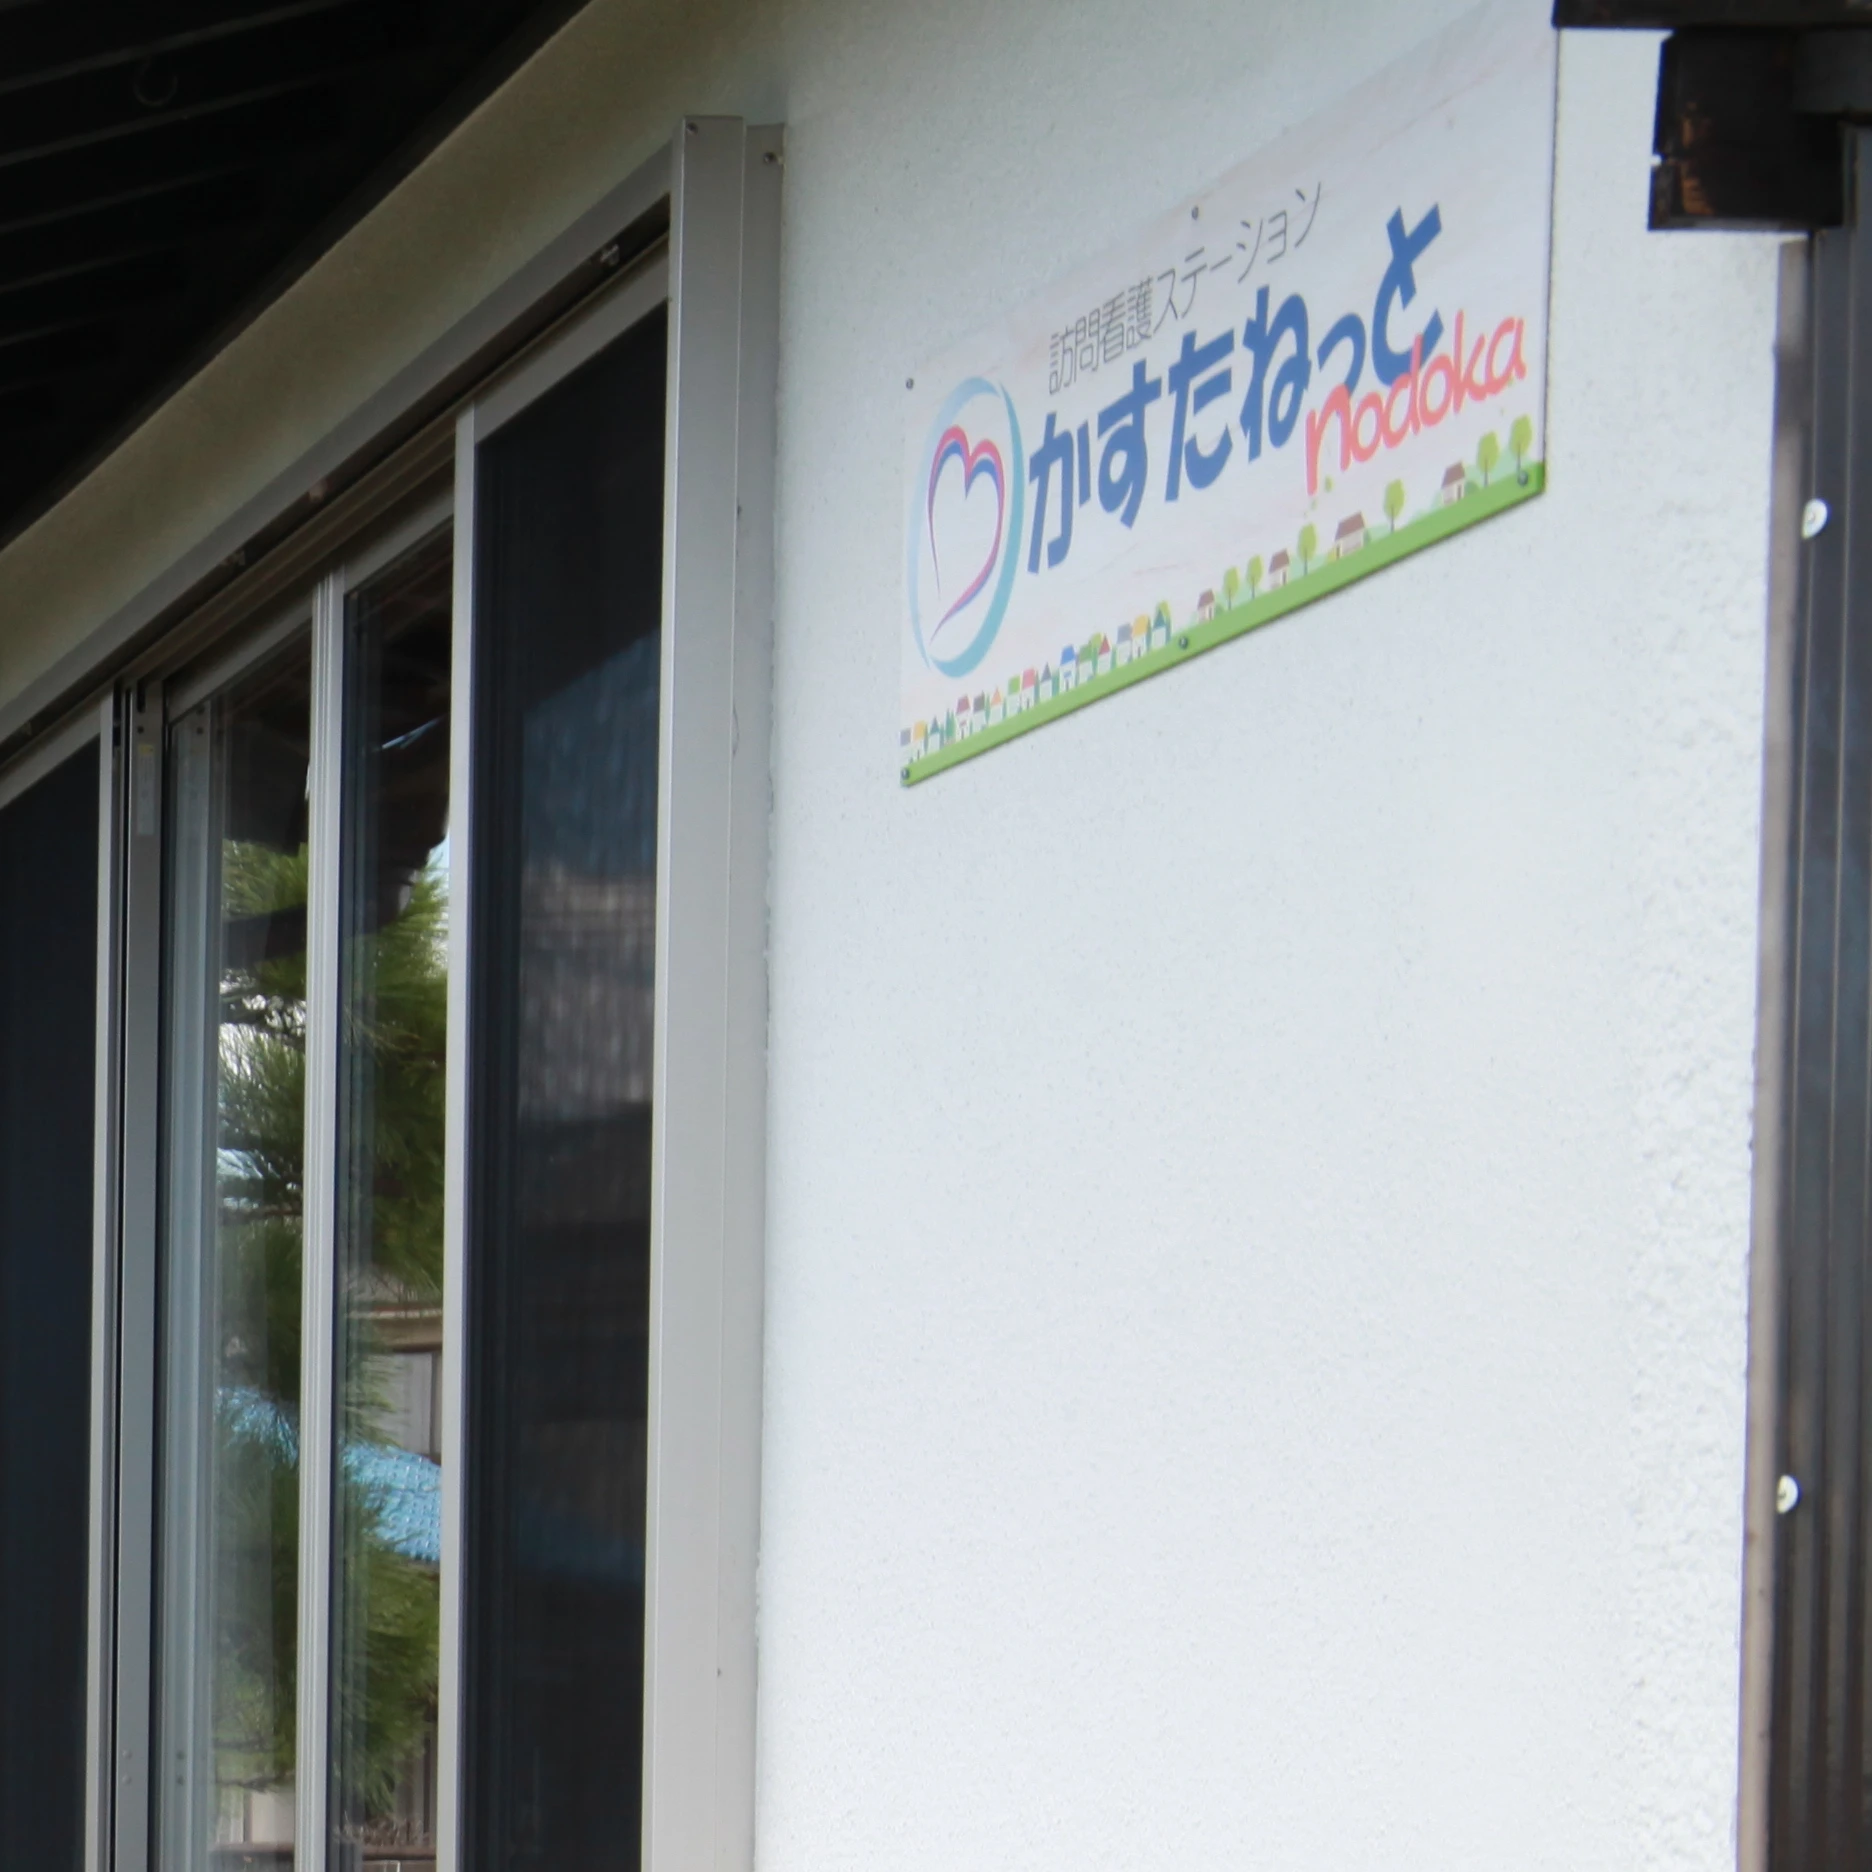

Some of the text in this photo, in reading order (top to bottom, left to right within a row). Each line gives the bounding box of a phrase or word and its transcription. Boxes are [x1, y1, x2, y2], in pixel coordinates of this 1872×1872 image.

[1027, 203, 1444, 574] かすたねっと
[1048, 182, 1322, 395] 訪問看護ステーション
[1305, 309, 1526, 495] nodoka
